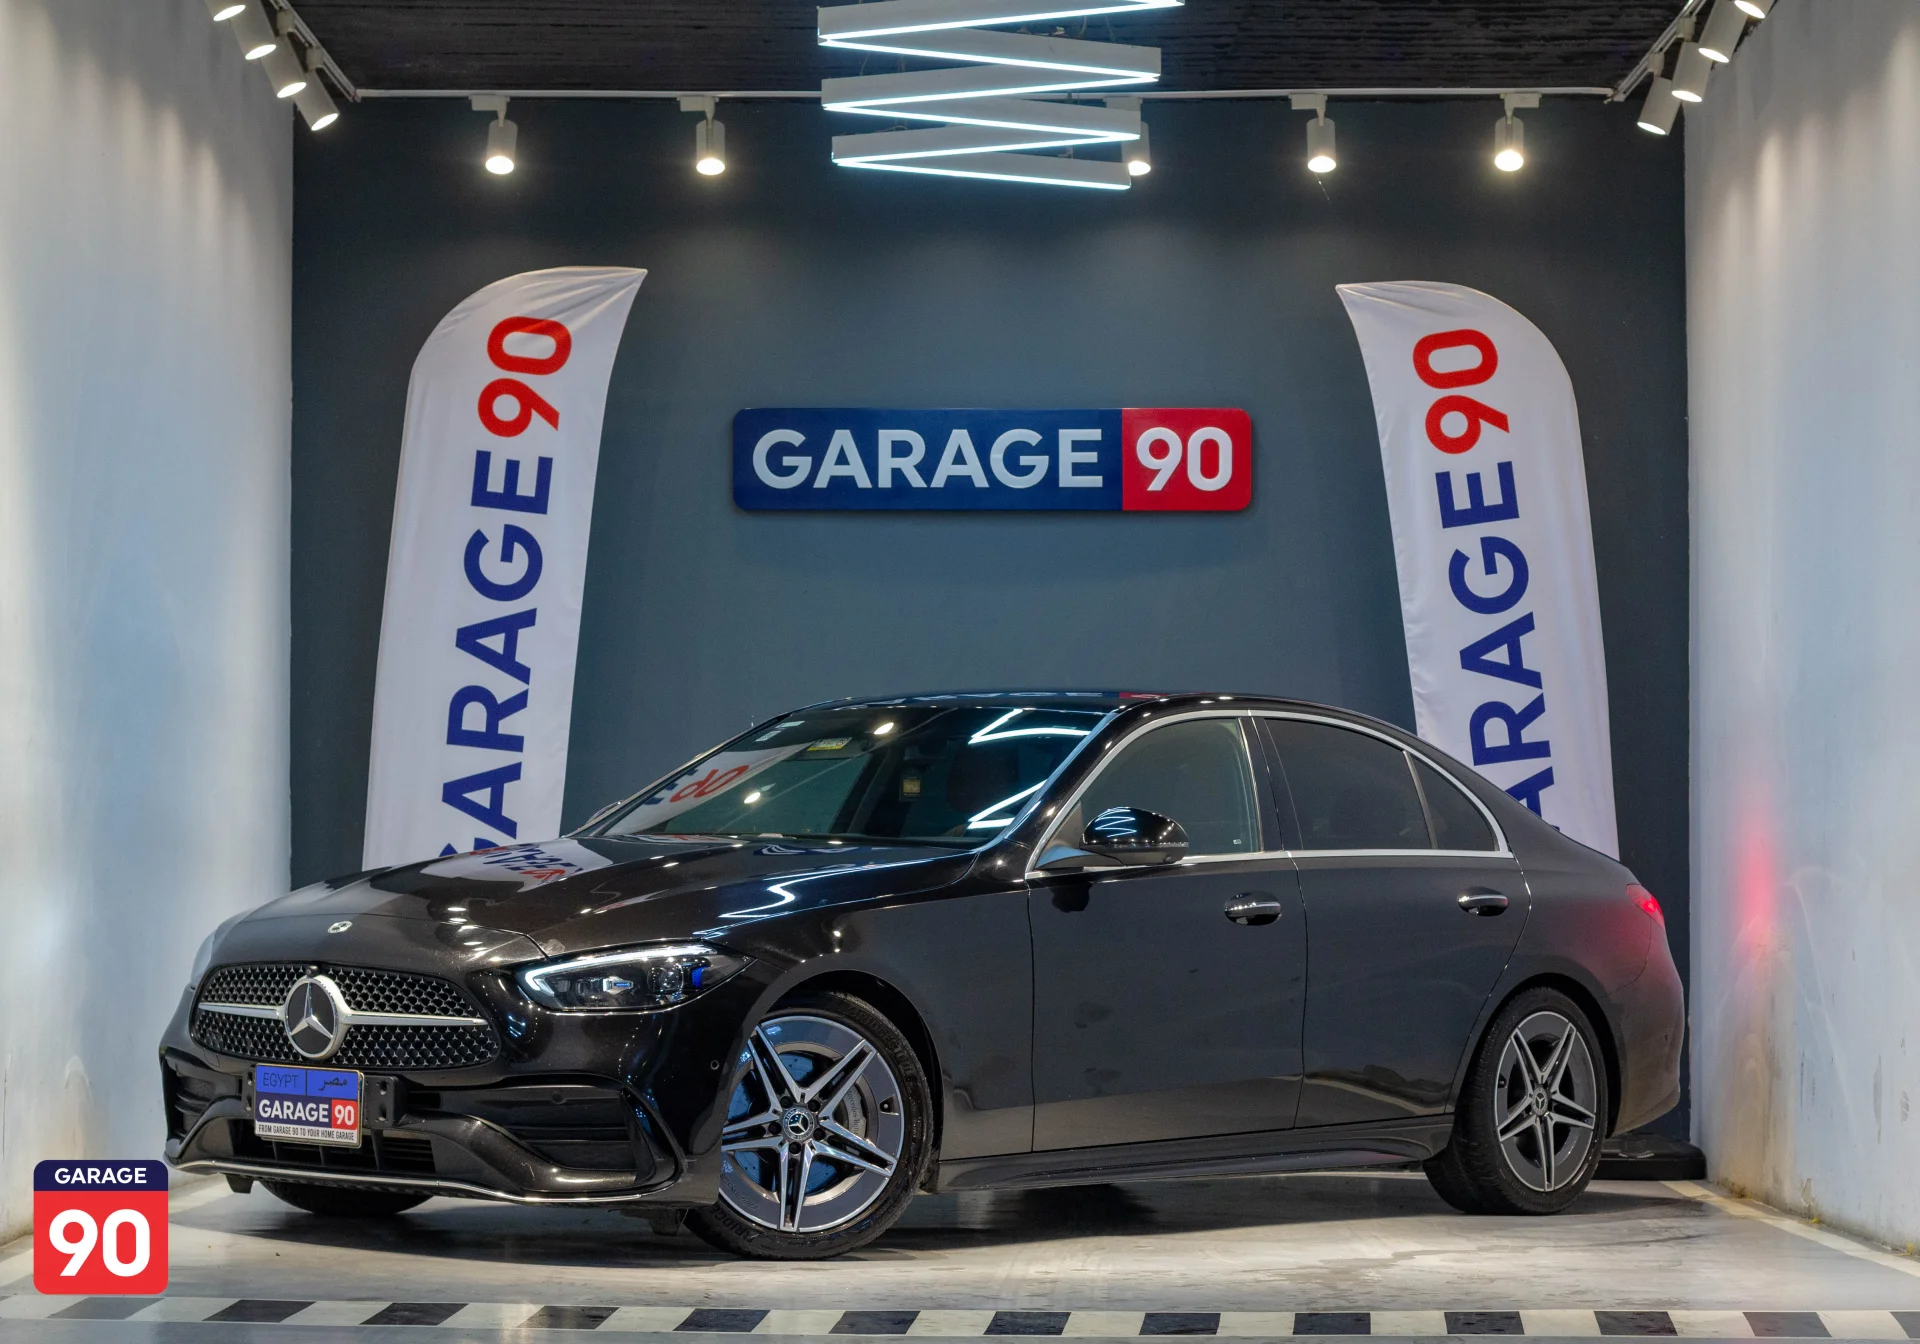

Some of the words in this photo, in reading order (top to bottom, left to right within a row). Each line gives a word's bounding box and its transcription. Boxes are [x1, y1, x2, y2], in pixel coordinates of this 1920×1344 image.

[477, 316, 572, 437] 90
[1412, 328, 1510, 455] 90
[753, 428, 1103, 489] GARAGE
[1136, 426, 1233, 491] 90
[439, 450, 553, 857] ARAGE
[1435, 461, 1560, 831] RAGE
[258, 1099, 329, 1123] GARAGE
[334, 1104, 355, 1126] 90
[263, 1072, 299, 1088] EGYPT
[318, 1077, 348, 1091] مصر
[258, 1124, 272, 1133] FROM
[272, 1125, 292, 1135] GARAGE
[292, 1127, 299, 1136] 90
[299, 1127, 306, 1137] TO
[307, 1128, 320, 1138] YOUR
[320, 1129, 335, 1139] HOME
[335, 1130, 354, 1141] GARAGE
